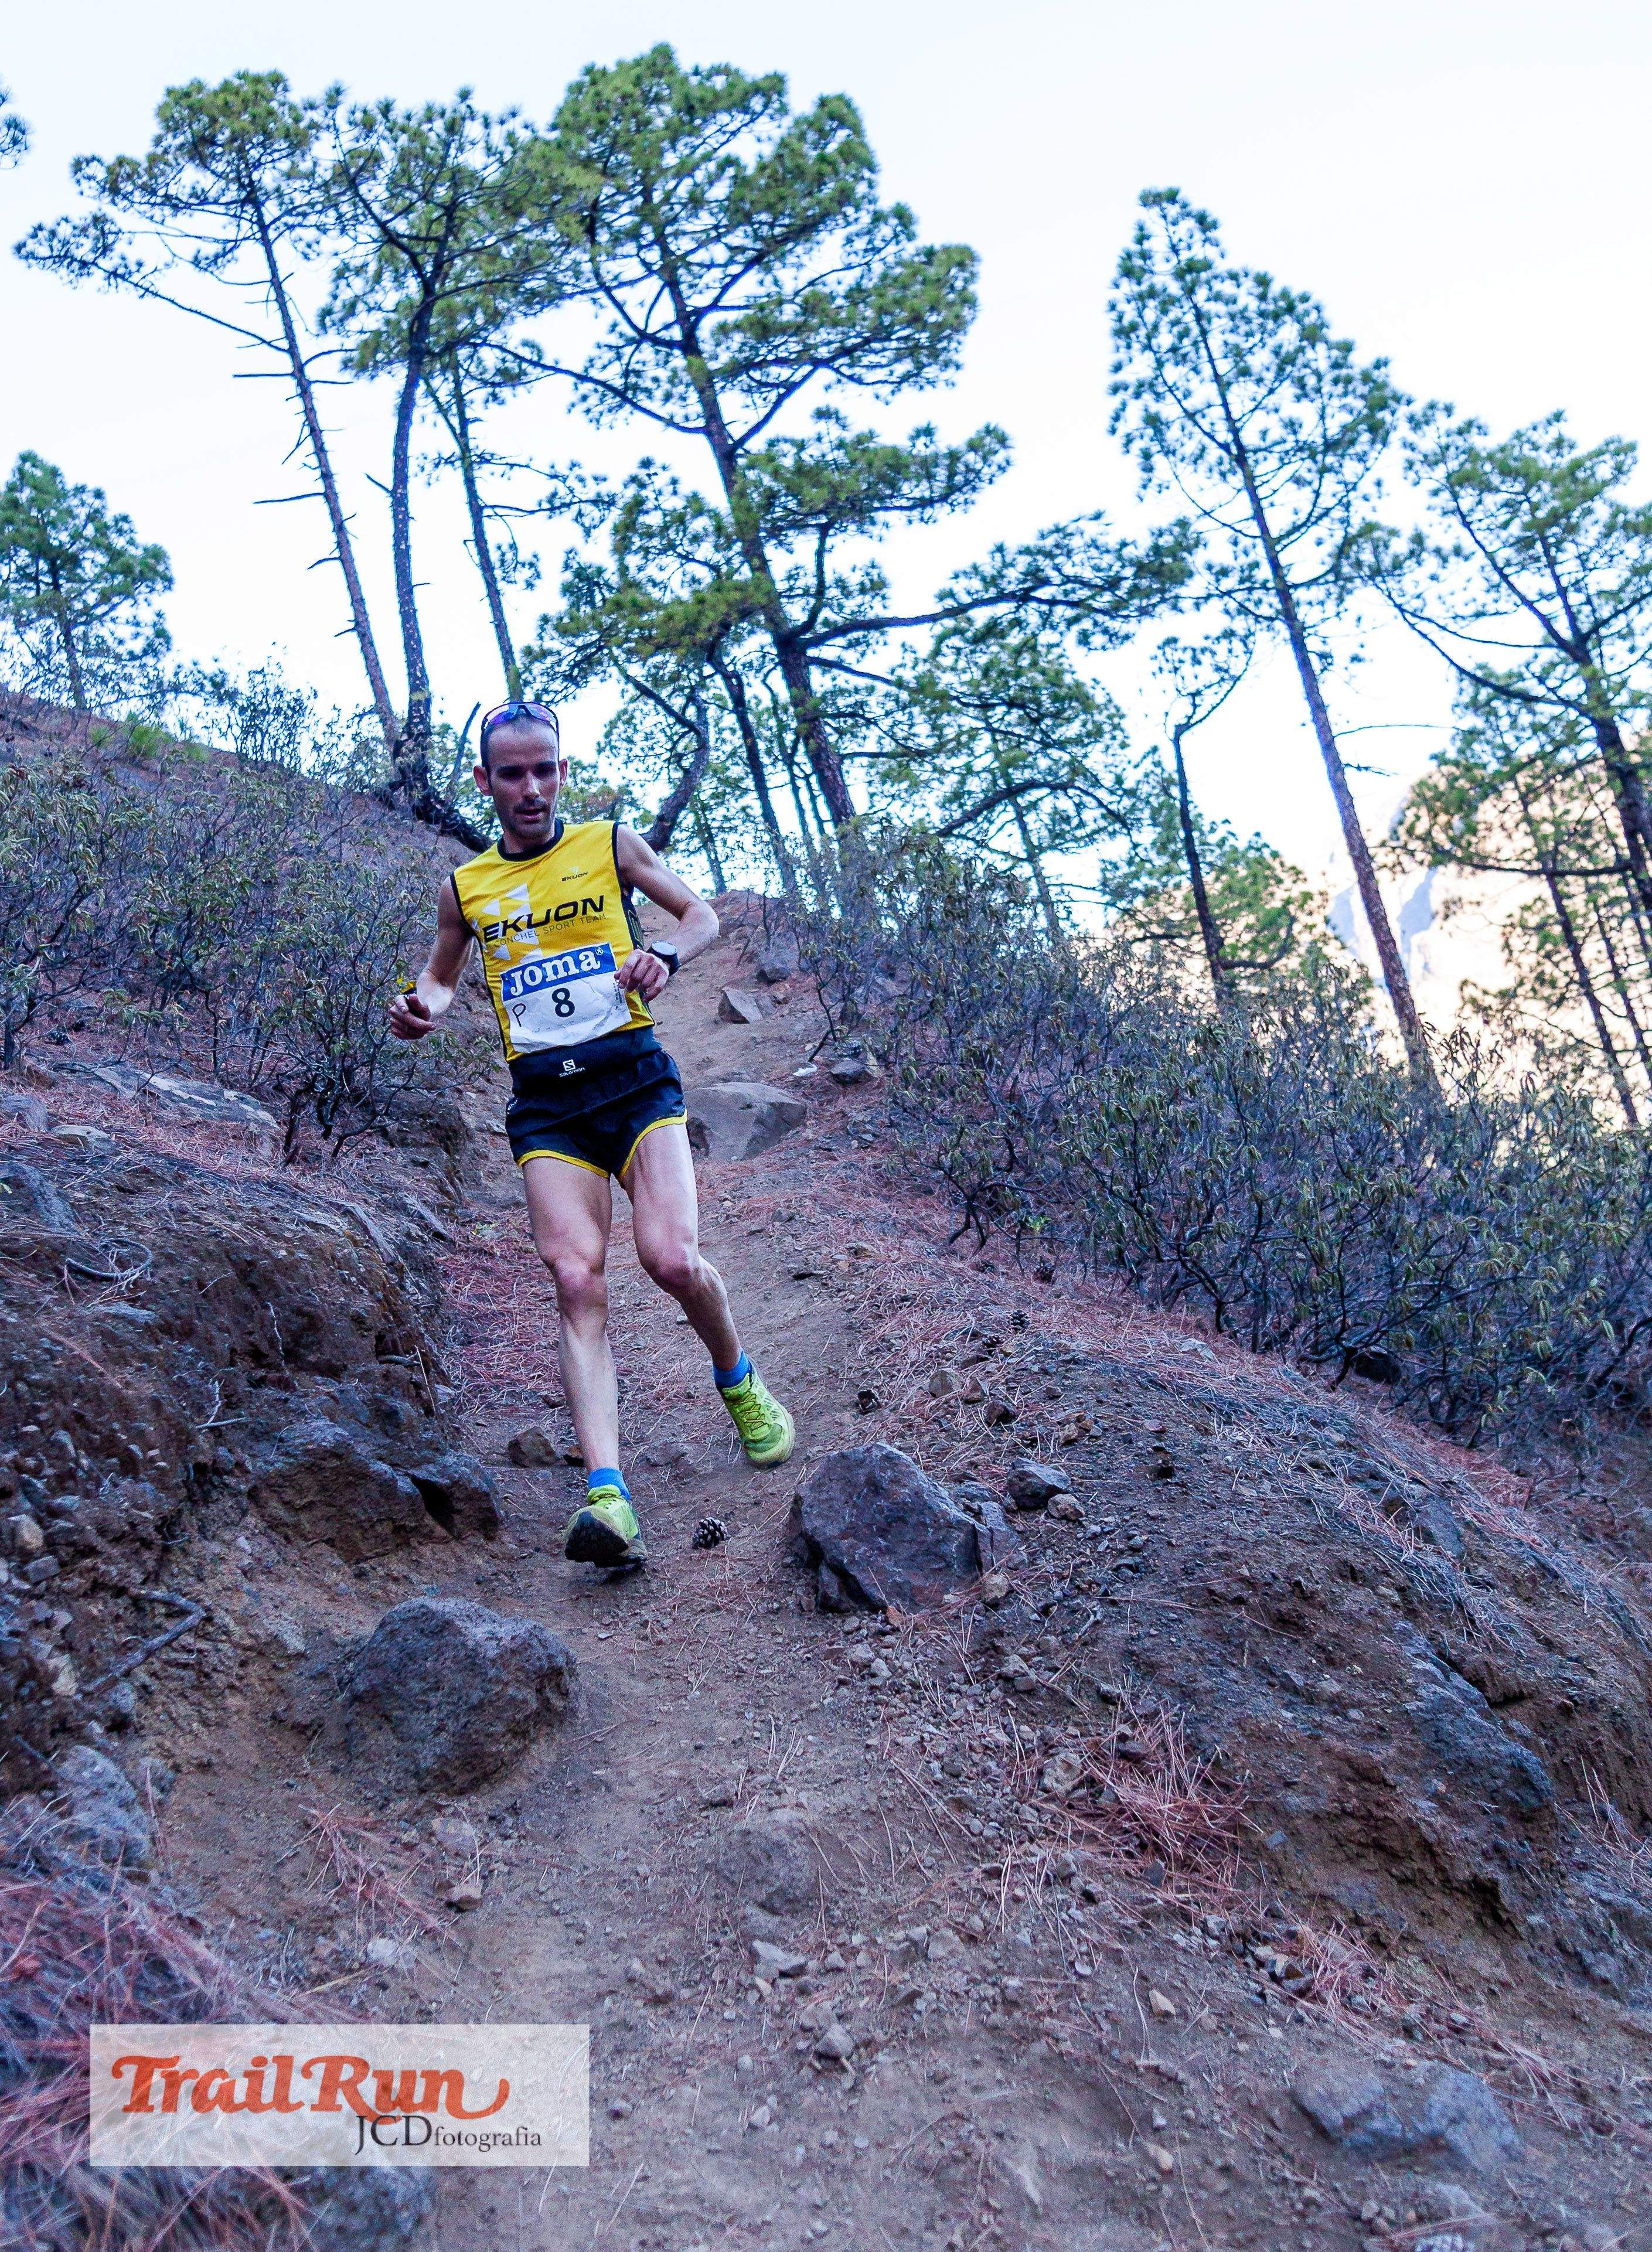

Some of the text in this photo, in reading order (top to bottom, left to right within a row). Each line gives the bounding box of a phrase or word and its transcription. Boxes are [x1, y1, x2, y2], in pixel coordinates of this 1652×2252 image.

[482, 895, 605, 943] EKUON
[543, 919, 575, 935] SPORT
[581, 913, 607, 925] TEAM
[512, 1003, 526, 1027] P
[551, 987, 575, 1018] 8
